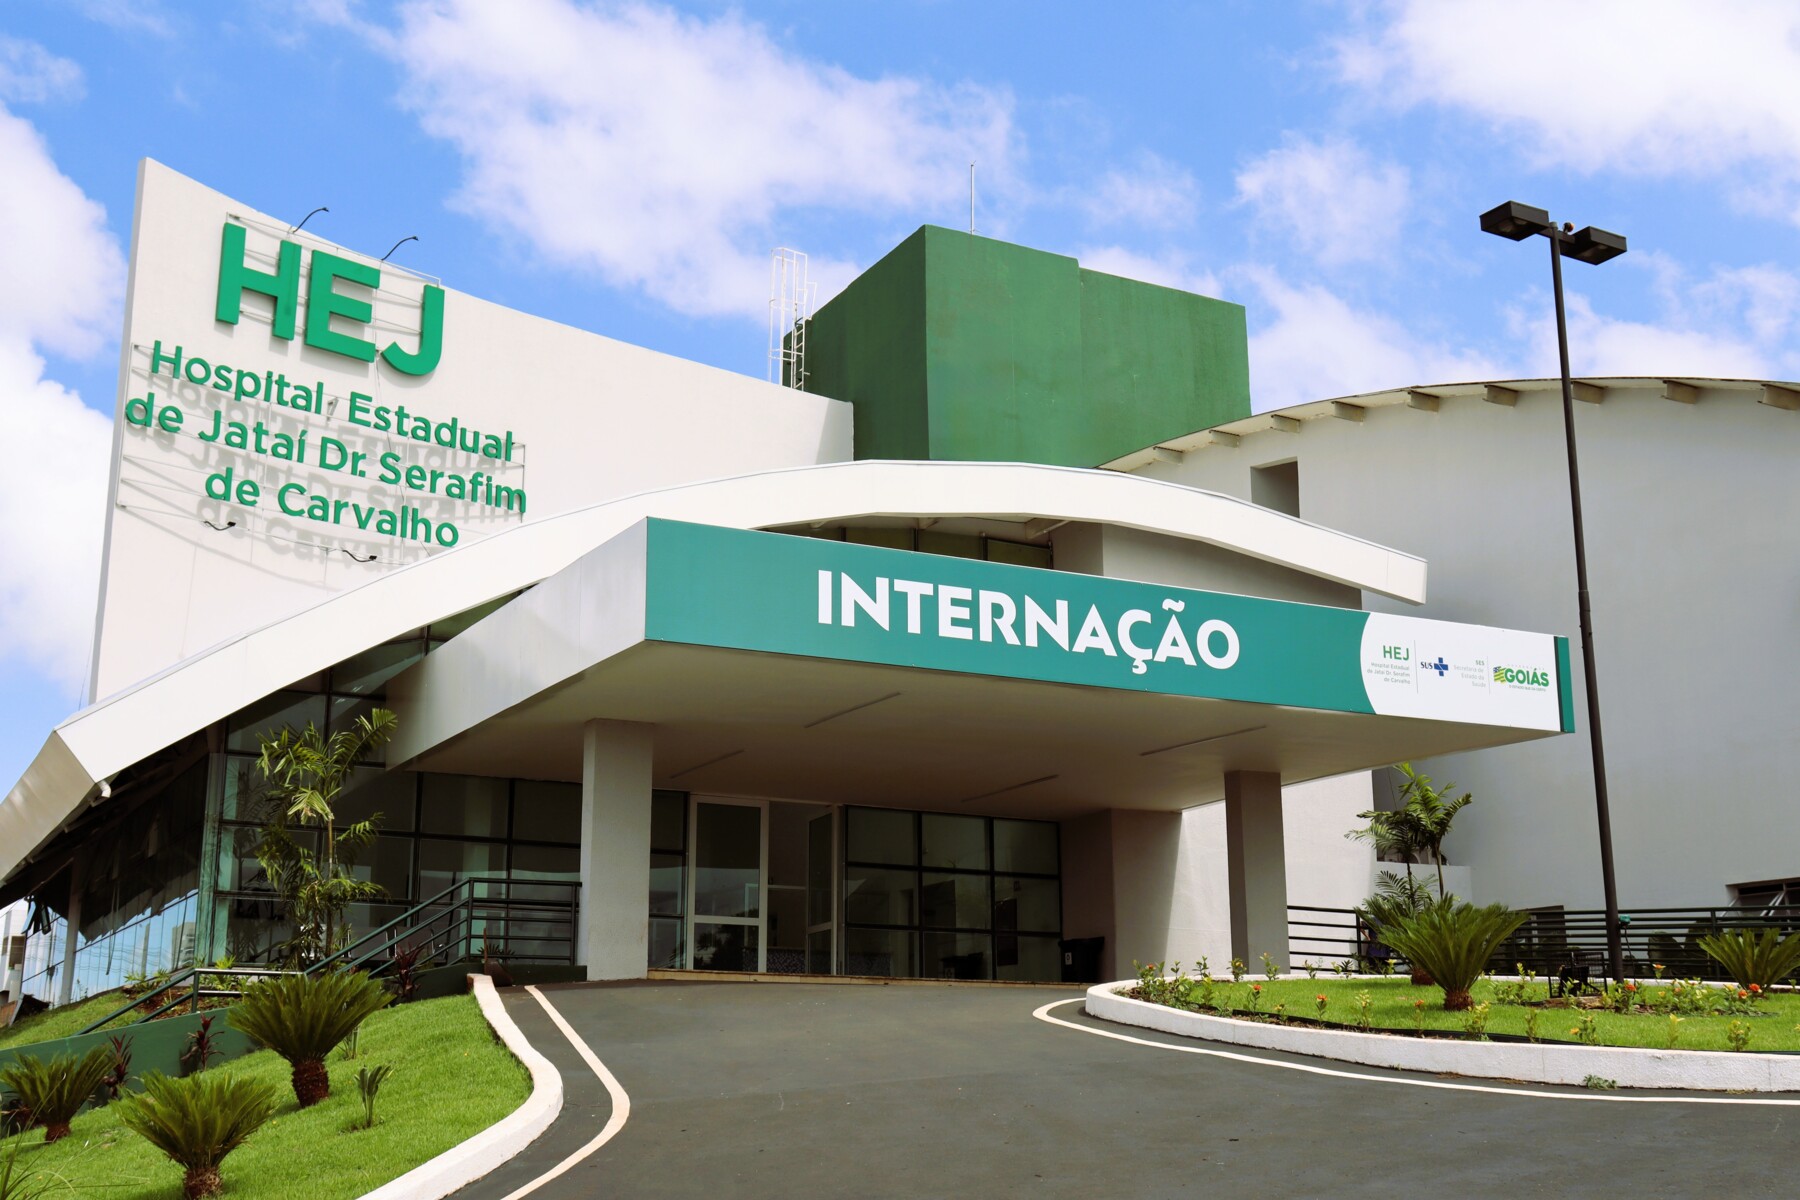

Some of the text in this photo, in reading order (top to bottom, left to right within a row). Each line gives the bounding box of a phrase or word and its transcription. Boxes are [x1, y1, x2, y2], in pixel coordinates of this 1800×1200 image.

[216, 222, 445, 377] HEJ
[151, 340, 513, 462] Hospital Estadual
[126, 392, 527, 513] de Jataí Dr. Serafim
[205, 467, 460, 548] de Carvalho
[818, 569, 1240, 675] INTERNAÇÃO
[1383, 645, 1410, 661] HEJ
[1420, 661, 1433, 670] SUS
[1504, 667, 1549, 687] GOIÁS
